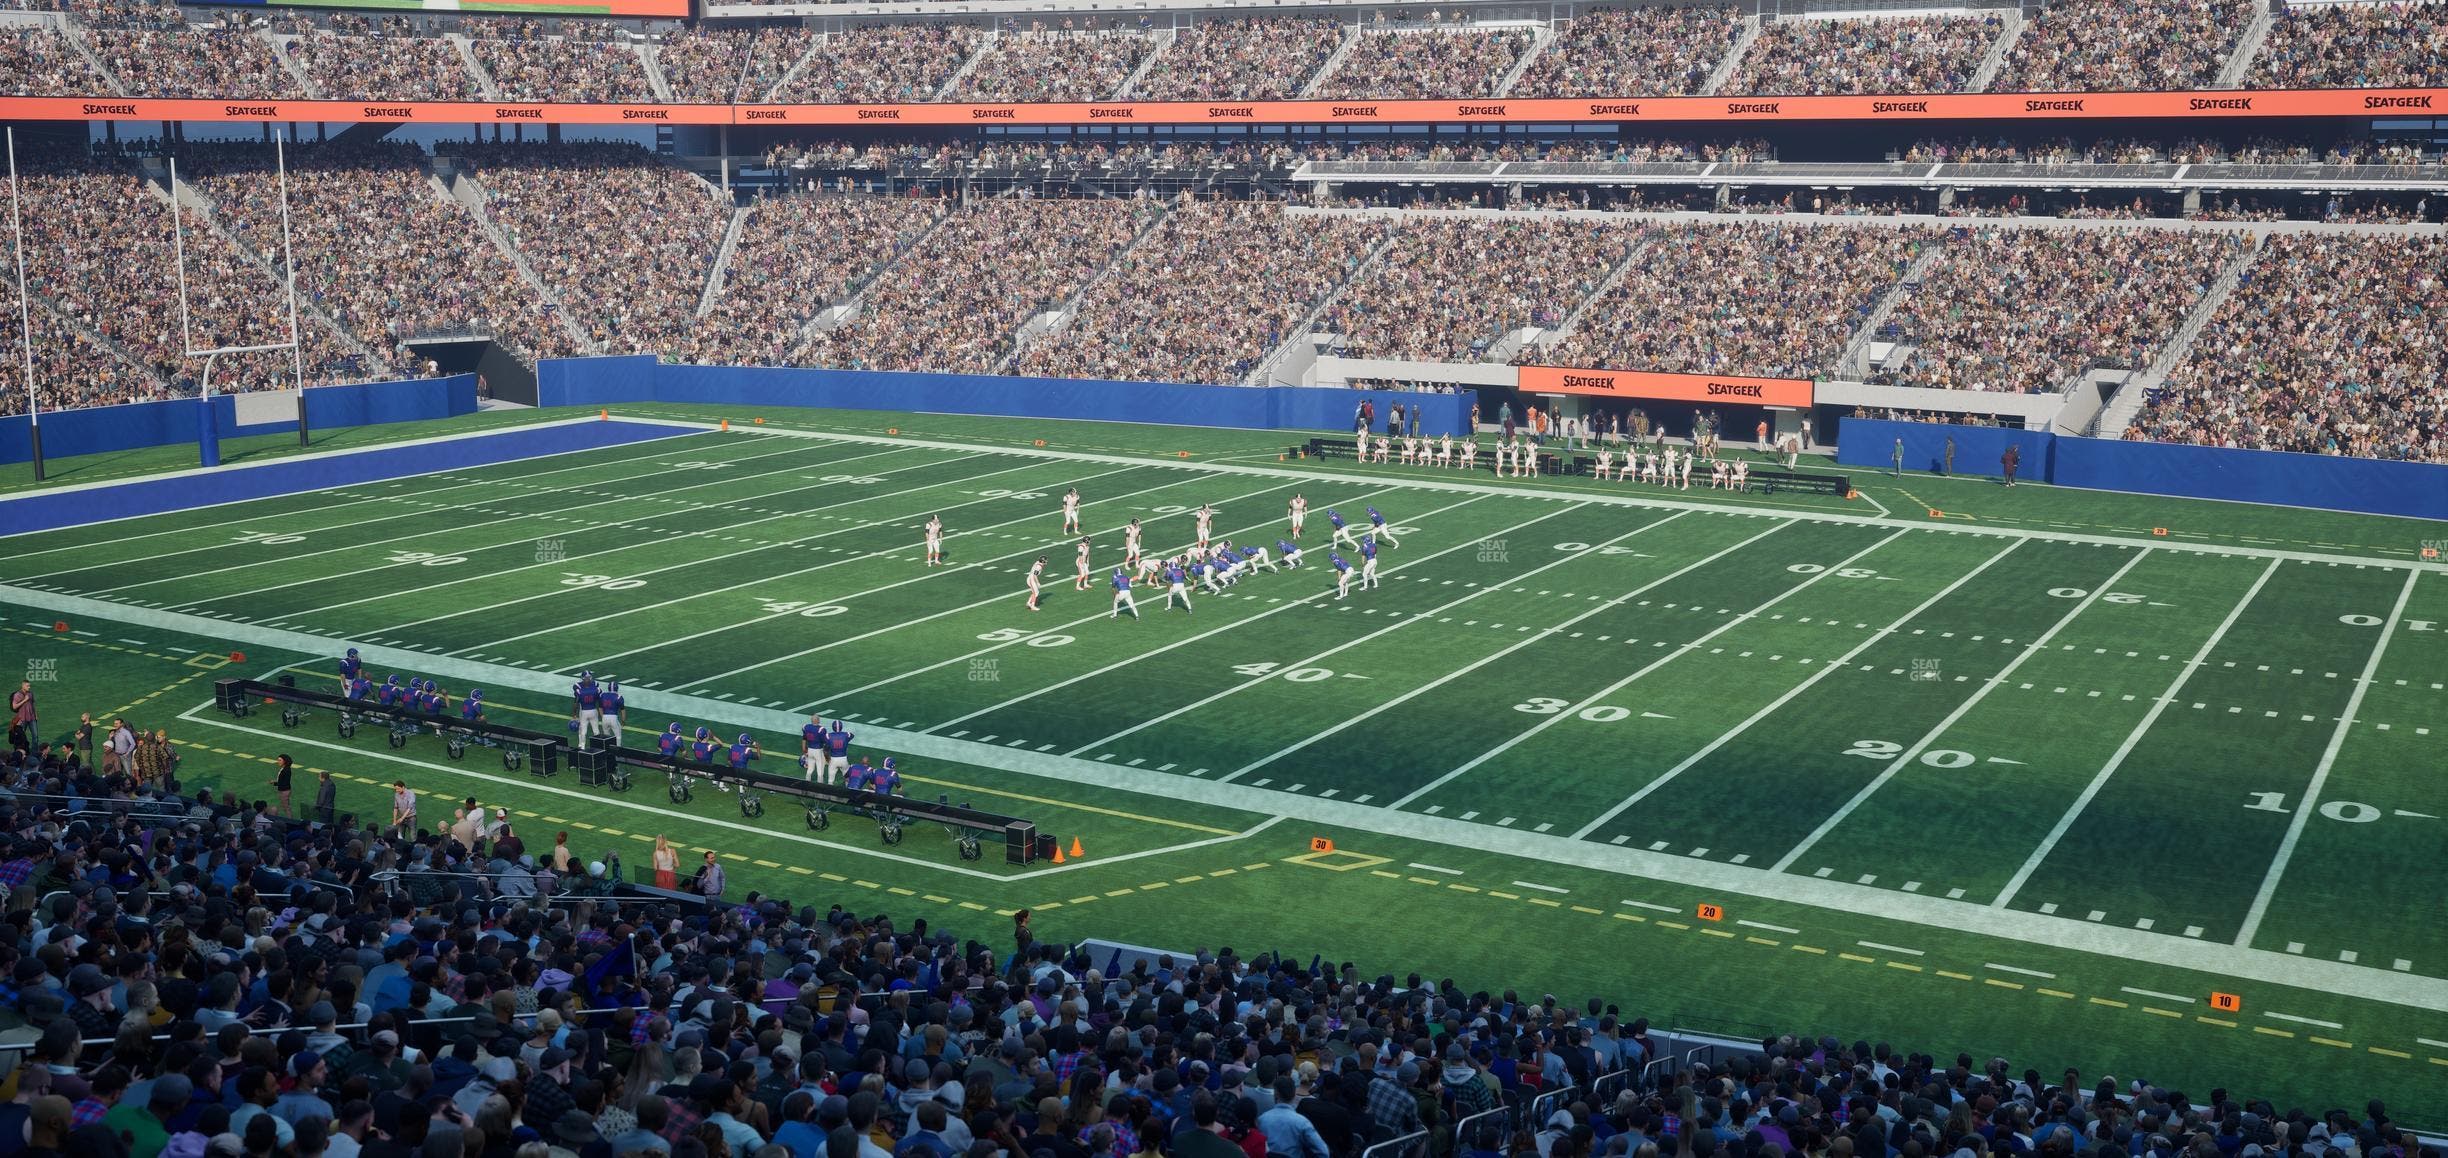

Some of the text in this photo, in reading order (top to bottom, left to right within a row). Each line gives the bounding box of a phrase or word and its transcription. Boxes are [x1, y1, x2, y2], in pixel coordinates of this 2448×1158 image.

[1872, 101, 1928, 113] SEATGEEK
[2025, 99, 2084, 112] SEATGEEK
[2189, 97, 2252, 111] SEATGEEK
[2364, 95, 2432, 109] SEATGEEK
[82, 103, 137, 116] SEATGEEK
[225, 105, 278, 117] SEATGEEK
[364, 107, 412, 118] SEATGEEK
[495, 108, 543, 119] SEATGEEK
[622, 109, 668, 120] SEATGEEK
[858, 109, 900, 119] SEATGEEK
[972, 109, 1015, 119] SEATGEEK
[1089, 108, 1133, 119] SEATGEEK
[1208, 107, 1254, 118] SEATGEEK
[1332, 106, 1378, 117] SEATGEEK
[1458, 105, 1506, 116] SEATGEEK
[1590, 104, 1640, 116] SEATGEEK
[1727, 102, 1780, 115] SEATGEEK
[746, 110, 787, 120] SEATGEEK
[1563, 374, 1615, 390] SEATGEEK
[1707, 382, 1762, 398] SEATGEEK
[976, 627, 1076, 648] 50
[1231, 661, 1334, 683] 40
[1513, 697, 1632, 723] 30
[1841, 739, 1976, 769] 20
[2243, 791, 2382, 824] 10
[1315, 839, 1327, 850] 30
[1703, 906, 1716, 918] 20
[2219, 995, 2232, 1008] 10
